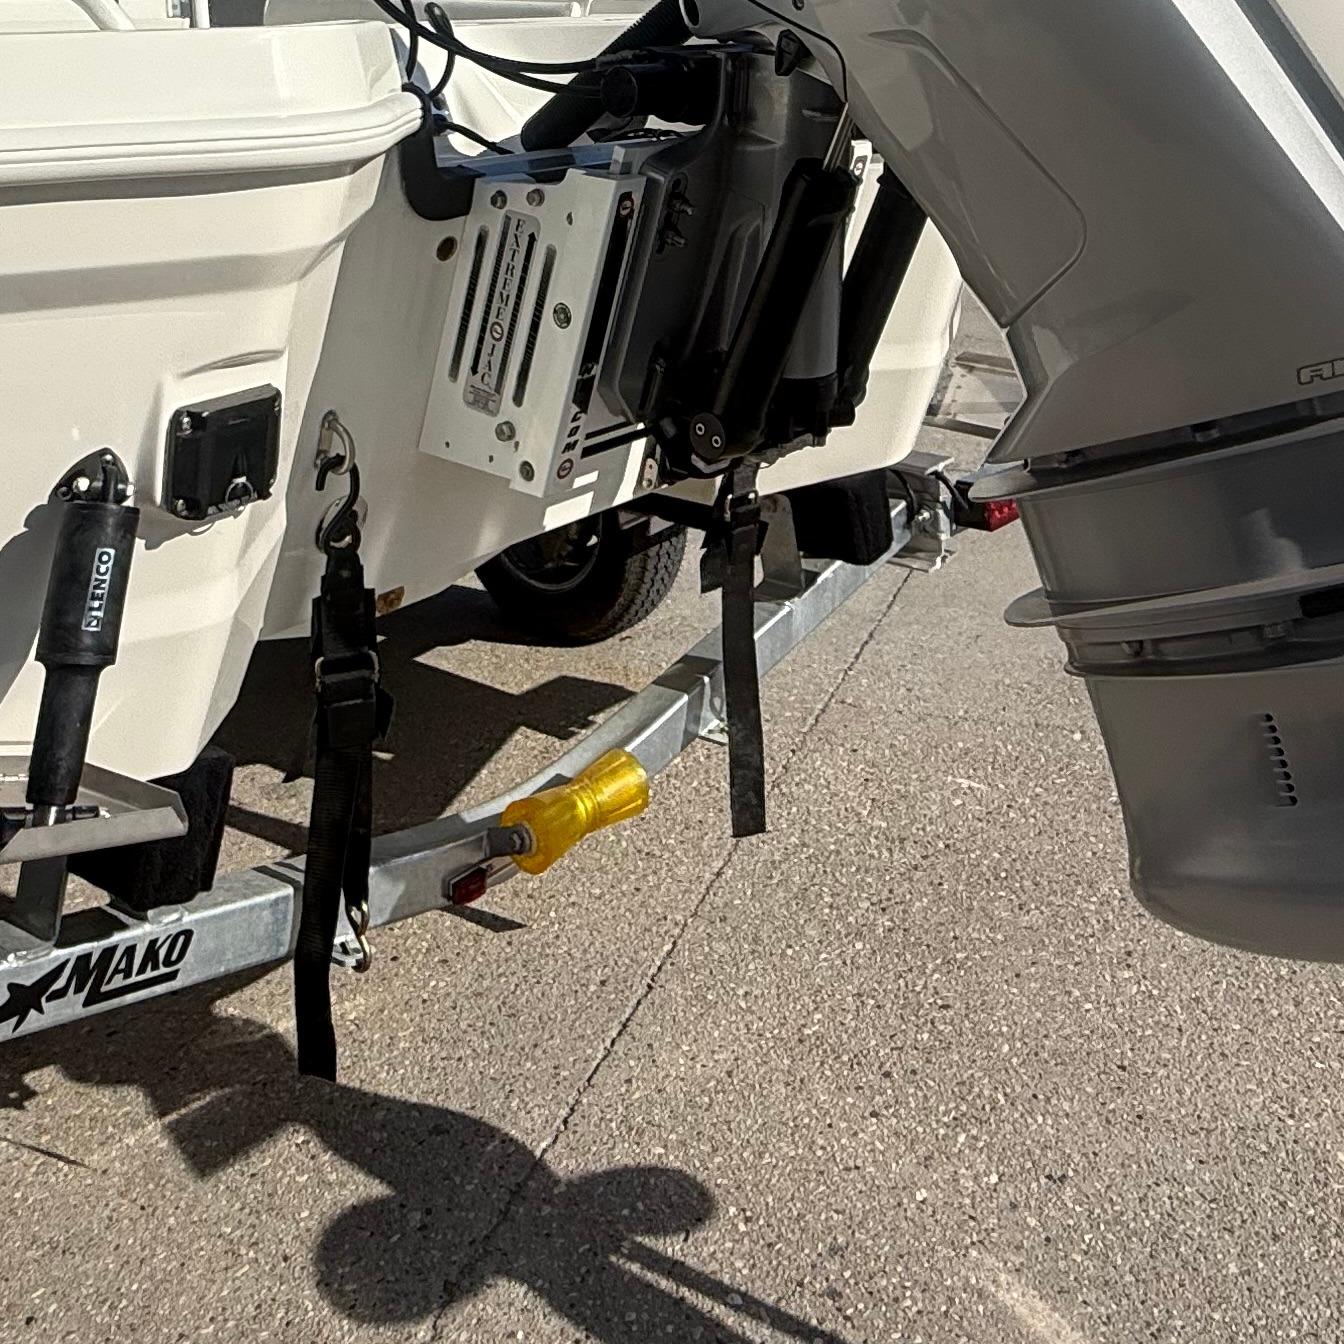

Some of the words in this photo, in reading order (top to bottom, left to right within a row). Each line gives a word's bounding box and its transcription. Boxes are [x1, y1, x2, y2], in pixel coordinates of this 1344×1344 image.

[495, 217, 526, 321] EXTREME
[87, 550, 112, 612] LENCO
[45, 928, 194, 1009] MAKO
